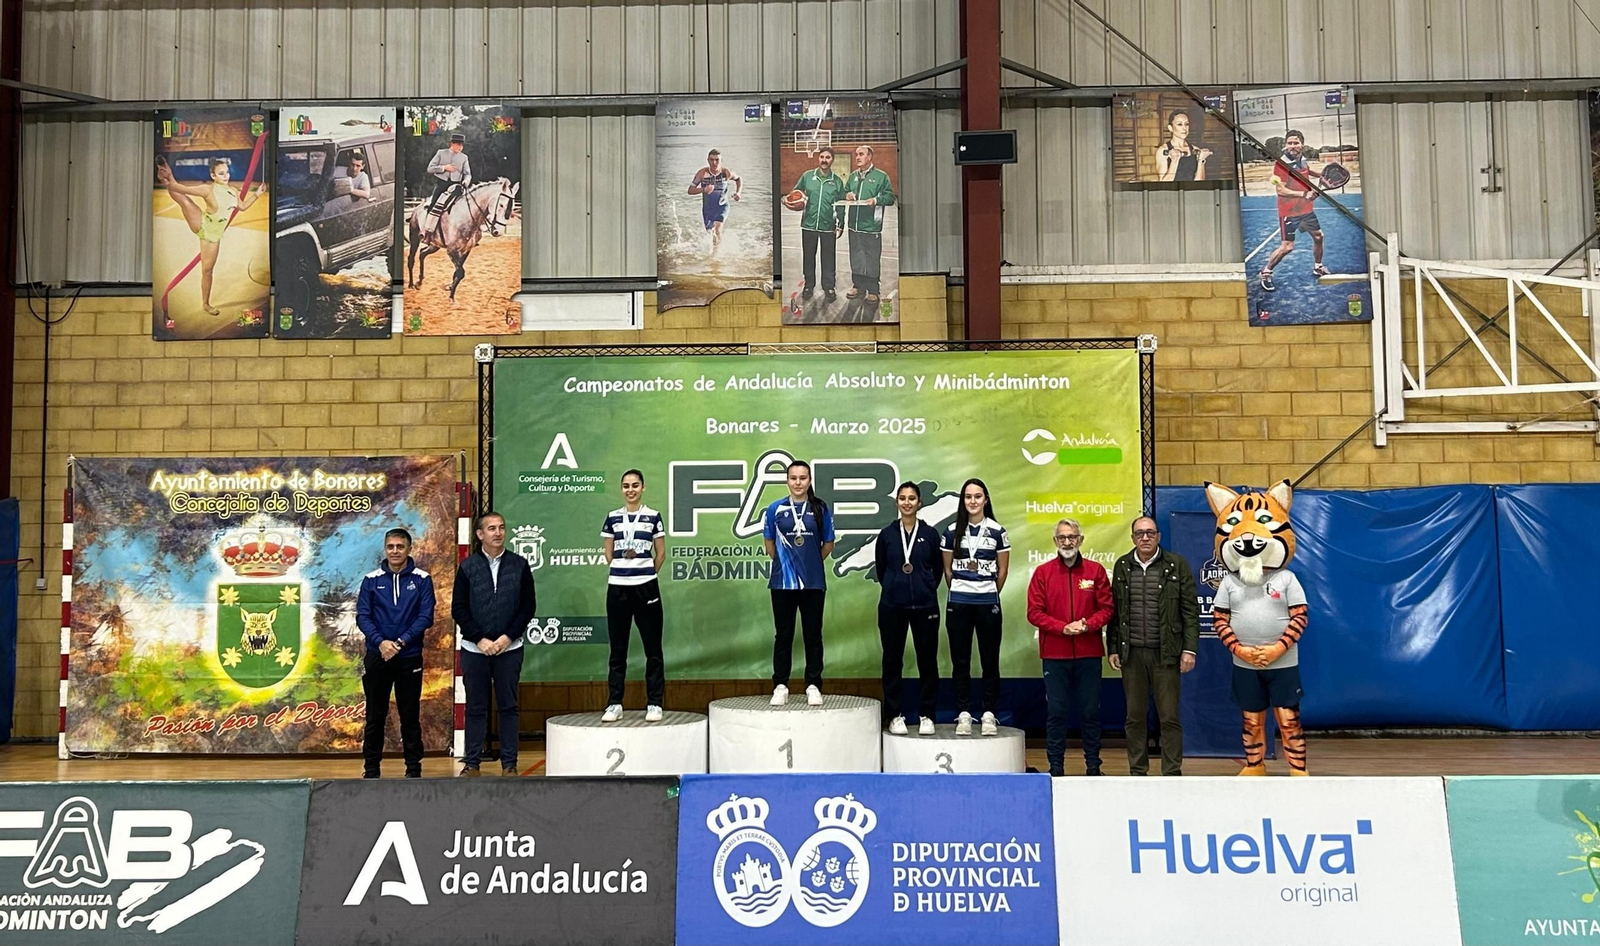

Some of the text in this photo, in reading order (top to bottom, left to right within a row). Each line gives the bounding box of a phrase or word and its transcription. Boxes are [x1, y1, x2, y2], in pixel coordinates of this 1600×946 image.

[563, 371, 1070, 397] Campeonatos de Andalucía Absoluto y Minibádminton
[706, 418, 780, 434] Bonares
[810, 418, 869, 434] Marzo
[878, 418, 926, 434] 2025
[1061, 432, 1119, 446] Andalucía
[151, 470, 386, 497] Ayuntamiento de Bonares
[518, 474, 606, 484] Consejería de Turismo,
[528, 484, 557, 492] Cultura
[564, 484, 595, 494] Deporte
[264, 492, 288, 512] de
[294, 492, 370, 517] Deportes
[1026, 501, 1124, 516] Huelva original
[550, 556, 607, 566] HUELVA
[145, 715, 214, 737] Pasión
[217, 714, 258, 737] por
[264, 706, 289, 726] el
[605, 748, 626, 776] 2
[778, 738, 794, 768] 1
[935, 752, 954, 774] 3
[443, 830, 536, 858] Junta
[722, 838, 736, 855] MARIS
[744, 832, 766, 842] TERRAE
[892, 837, 1041, 864] DIPUTACIÓN
[1128, 818, 1356, 875] Huelva
[440, 859, 648, 894] de Andalucía
[892, 867, 1040, 888] PROVINCIAL
[42, 894, 112, 906] ANDALUZA
[918, 892, 1011, 912] HUELVA
[1280, 882, 1358, 906] original
